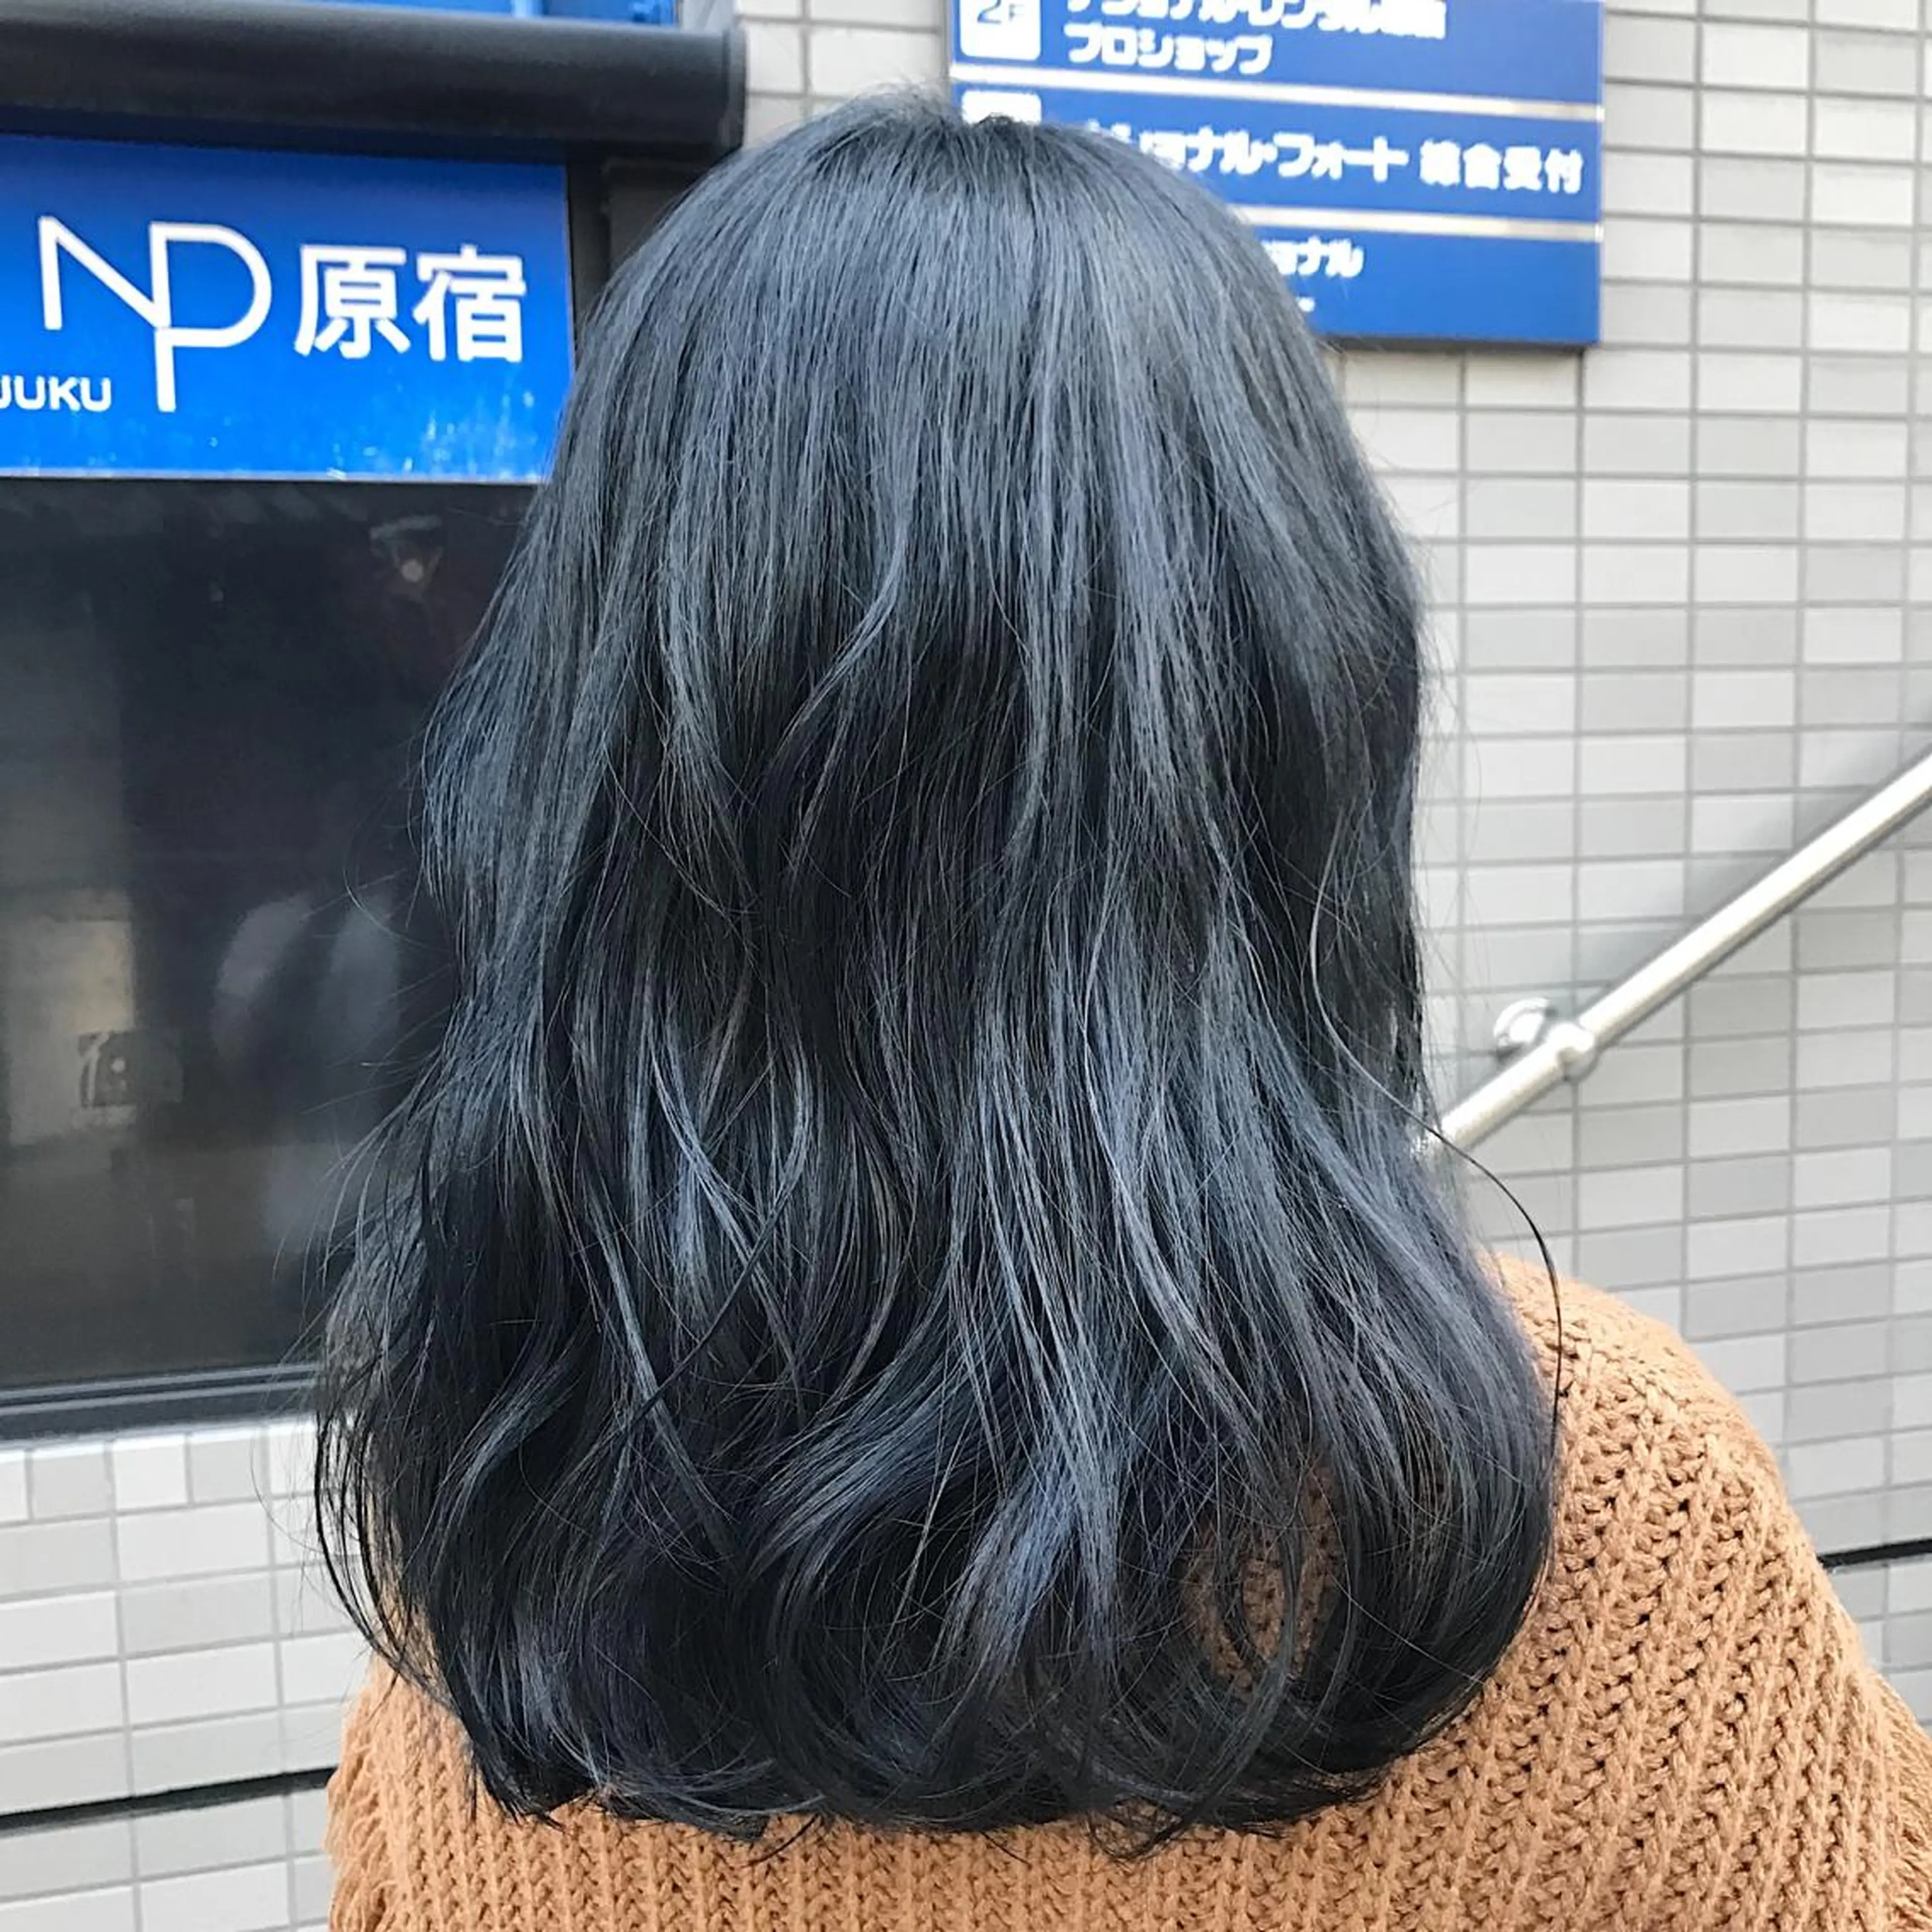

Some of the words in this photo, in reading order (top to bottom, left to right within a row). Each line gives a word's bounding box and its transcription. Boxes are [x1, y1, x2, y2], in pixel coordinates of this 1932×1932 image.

[1064, 21, 1272, 73] プロショップ
[294, 244, 526, 362] 原宿
